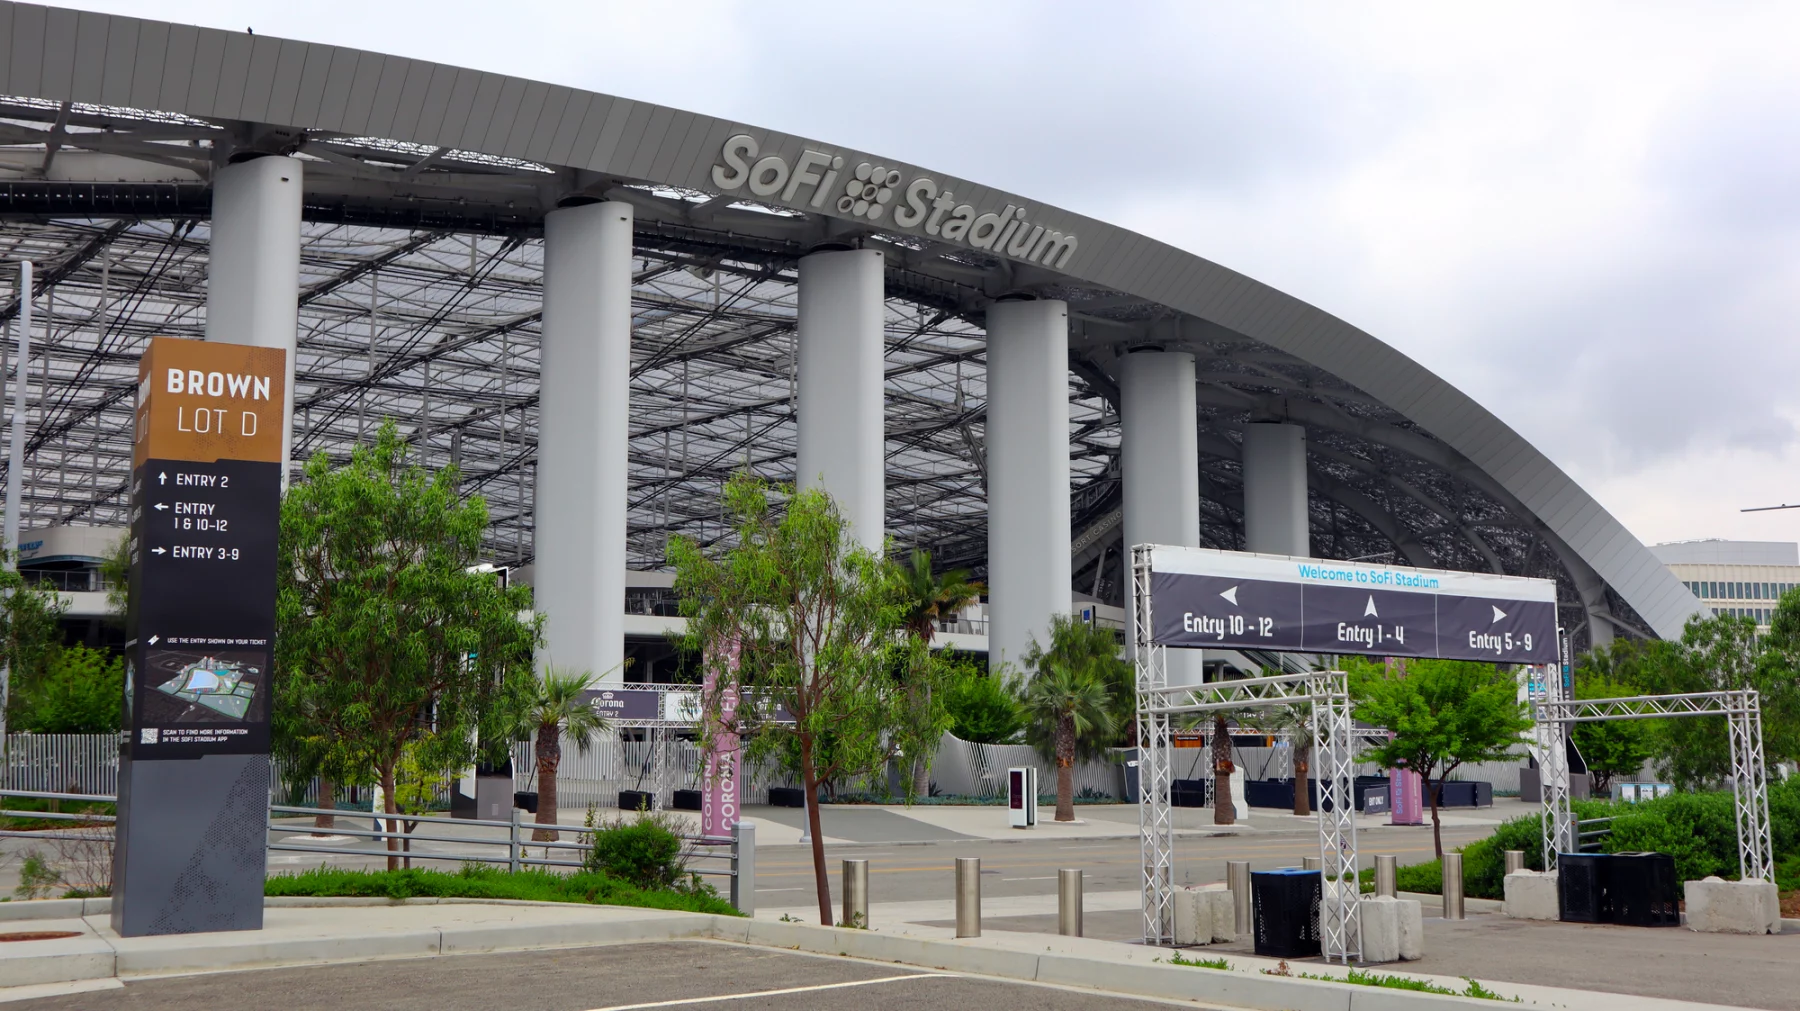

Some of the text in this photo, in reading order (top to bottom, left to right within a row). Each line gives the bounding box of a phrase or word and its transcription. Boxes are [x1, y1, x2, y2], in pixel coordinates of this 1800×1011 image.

[712, 134, 1078, 269] SoFi Stadium
[167, 368, 270, 401] BROWN
[178, 406, 228, 434] LOT
[241, 411, 257, 437] D
[176, 473, 229, 488] ENTRY 2
[174, 502, 215, 516] ENTRY
[174, 517, 228, 532] 1 & 10-12
[1071, 511, 1122, 553] SORT CASINO
[172, 545, 239, 561] ENTRY 3-9
[1298, 564, 1439, 589] Welcome to SoFi Stadium
[1183, 612, 1225, 641] Entry
[1228, 615, 1244, 636] 10
[1258, 617, 1273, 637] 12
[1337, 622, 1374, 649] Entry
[1377, 624, 1382, 643] 1
[1395, 626, 1404, 645] 4
[1469, 630, 1502, 655] Entry
[1505, 633, 1512, 650] 5
[1525, 634, 1532, 651] 9
[590, 697, 624, 710] Corona
